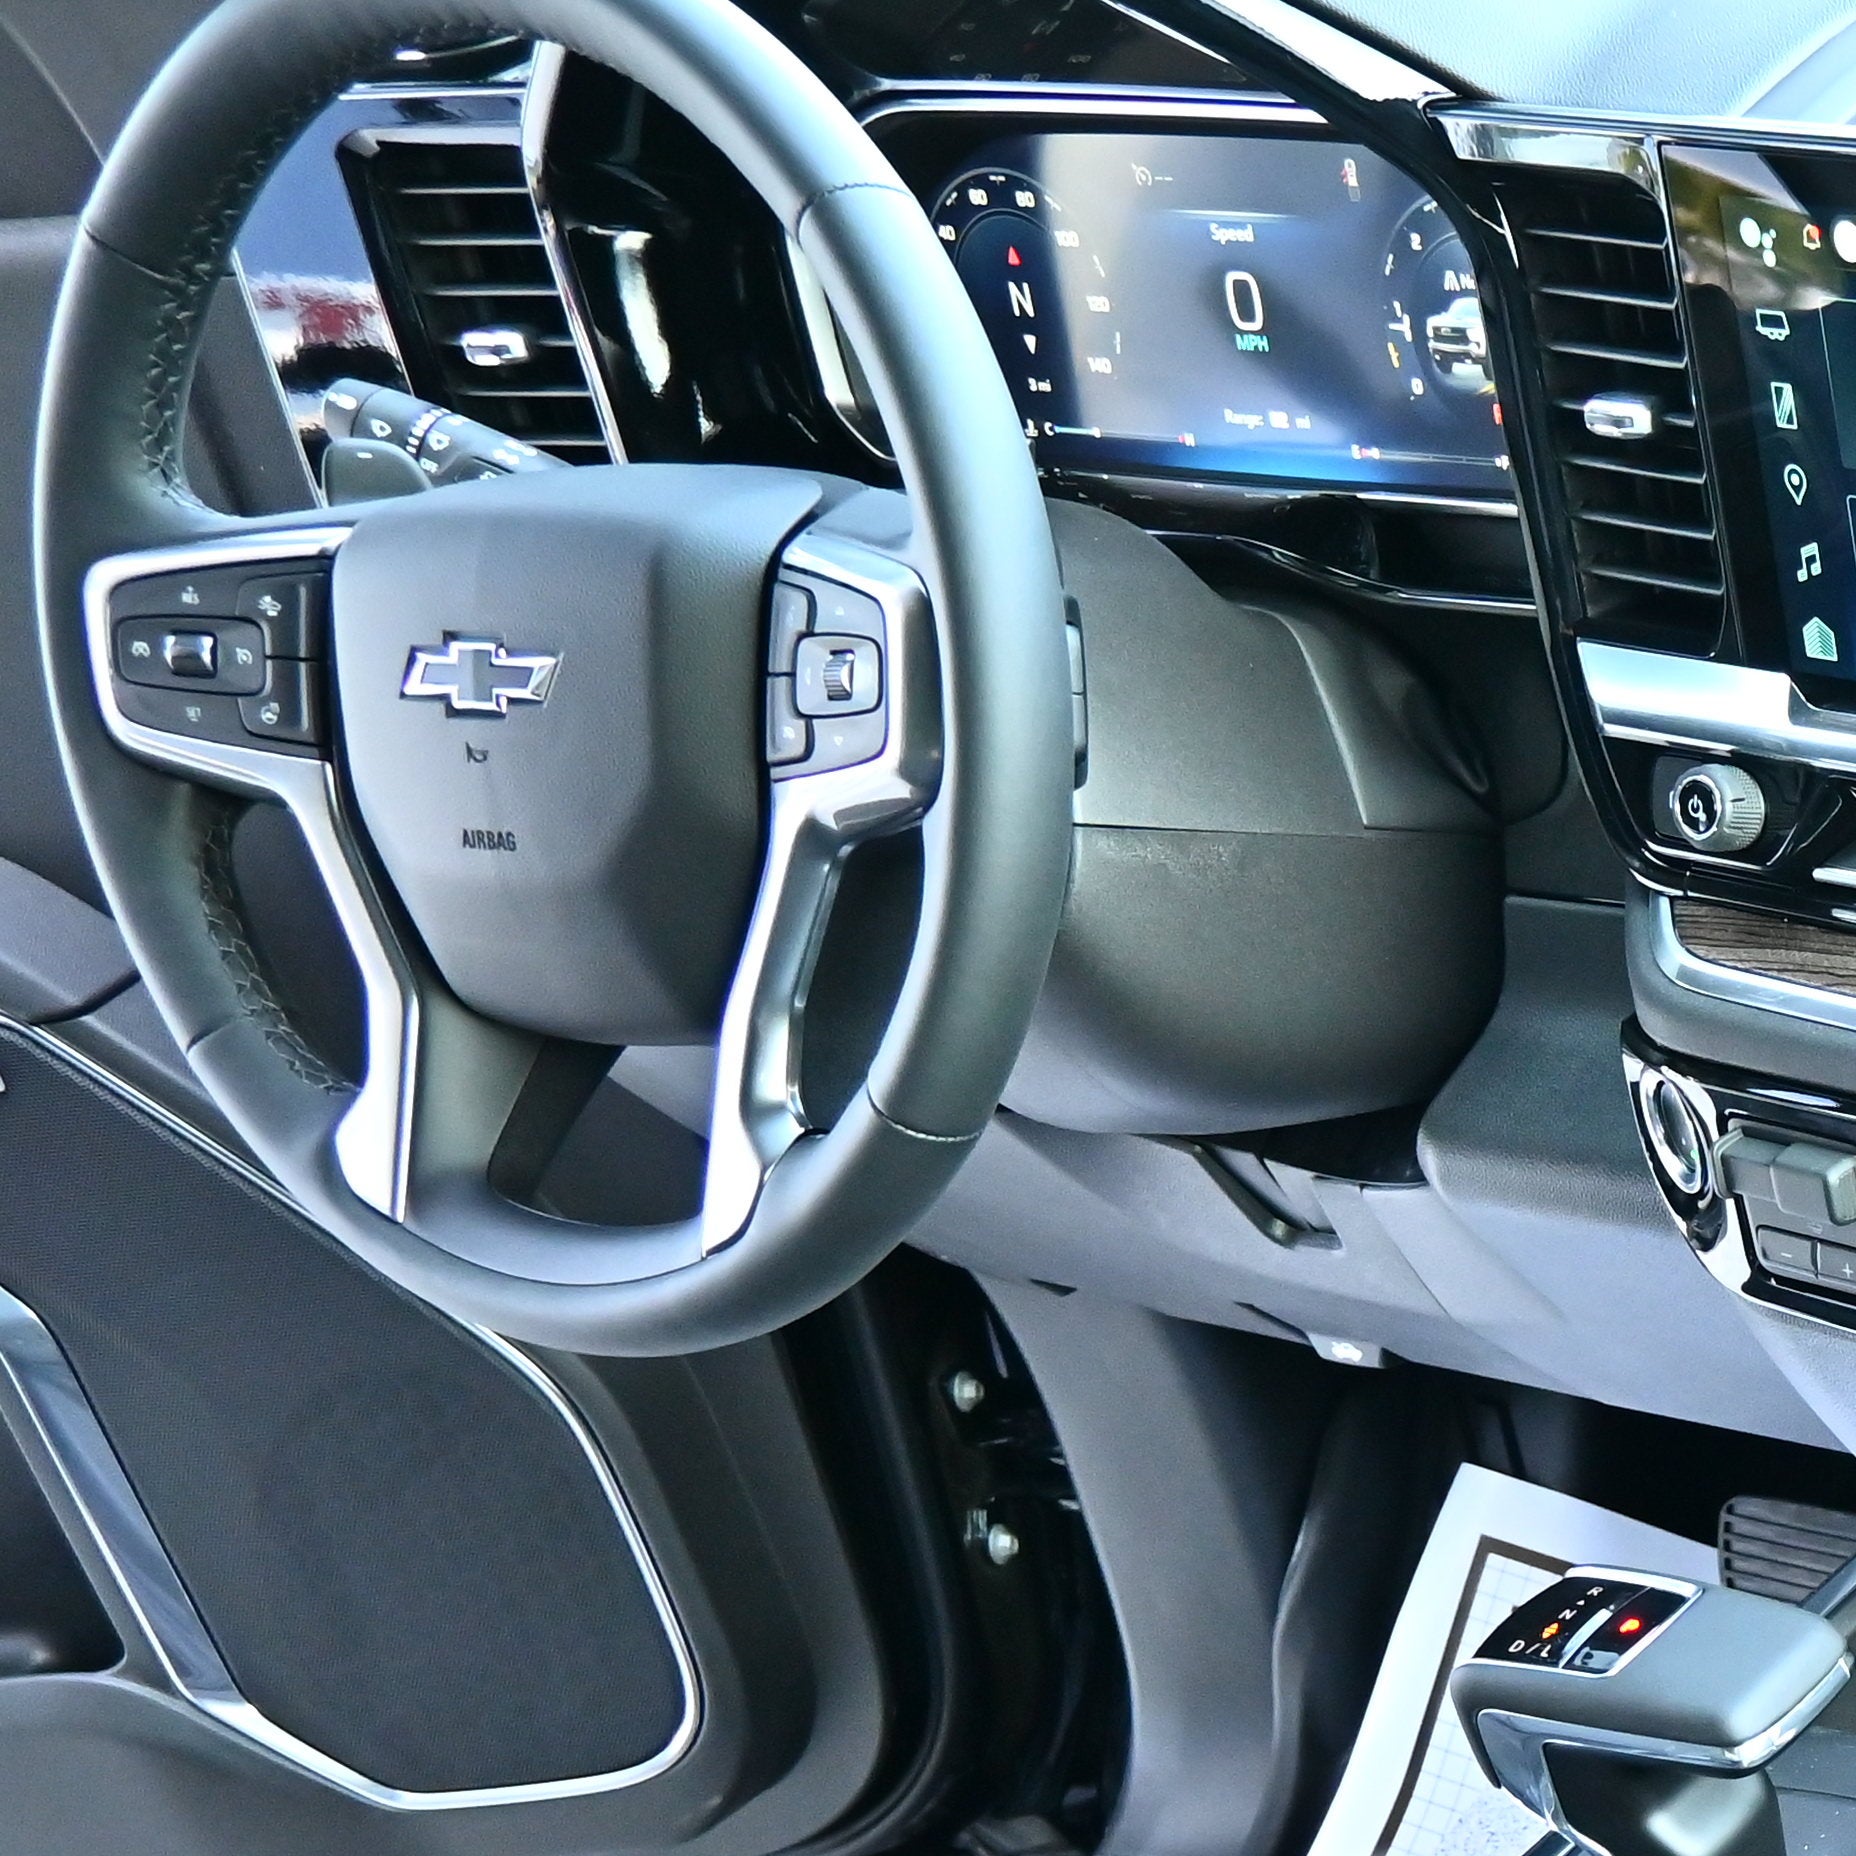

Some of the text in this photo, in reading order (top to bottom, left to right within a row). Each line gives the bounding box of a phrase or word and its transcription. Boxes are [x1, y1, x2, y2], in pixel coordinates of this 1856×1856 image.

[1210, 222, 1255, 245] Speed
[1007, 280, 1035, 318] N
[1224, 270, 1264, 332] 0
[1235, 334, 1270, 352] MPH
[462, 828, 517, 852] AIRBAG
[1587, 1586, 1604, 1597] R
[1558, 1608, 1578, 1620] N
